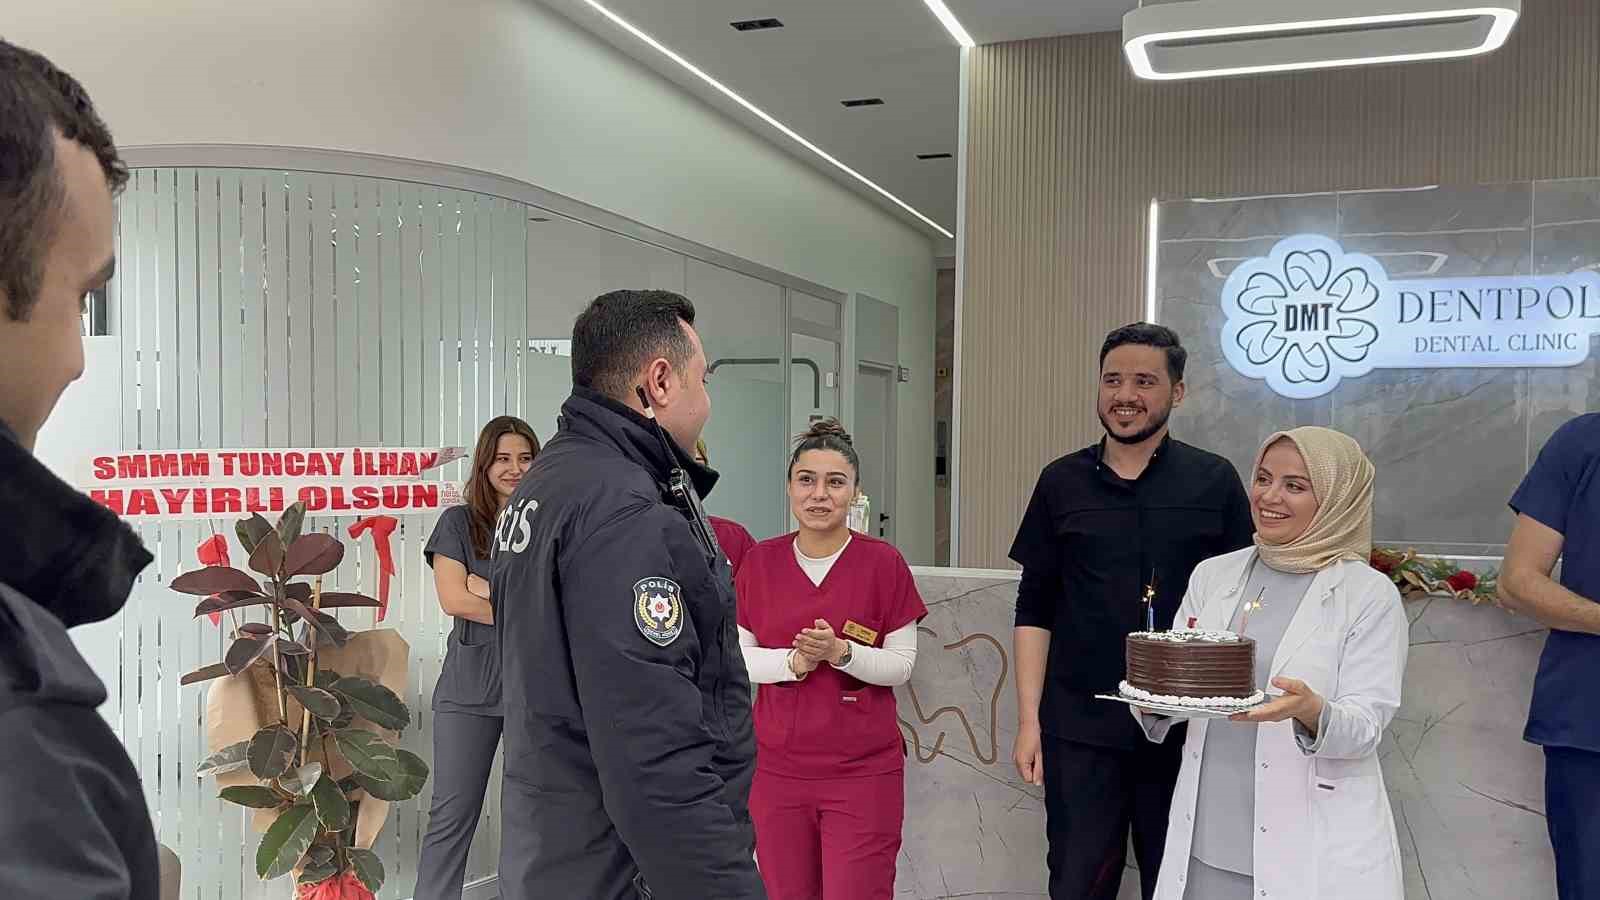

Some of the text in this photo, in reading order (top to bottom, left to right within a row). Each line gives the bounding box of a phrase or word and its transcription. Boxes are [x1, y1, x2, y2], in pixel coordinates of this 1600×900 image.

[1285, 303, 1333, 332] DMT
[1398, 285, 1600, 323] DENTPOL
[1415, 333, 1577, 353] DENTAL CLINIC
[94, 453, 209, 480] SMMM
[217, 452, 345, 476] TUNCAY
[90, 487, 284, 515] HAYIRLI
[299, 485, 438, 511] OLSUN
